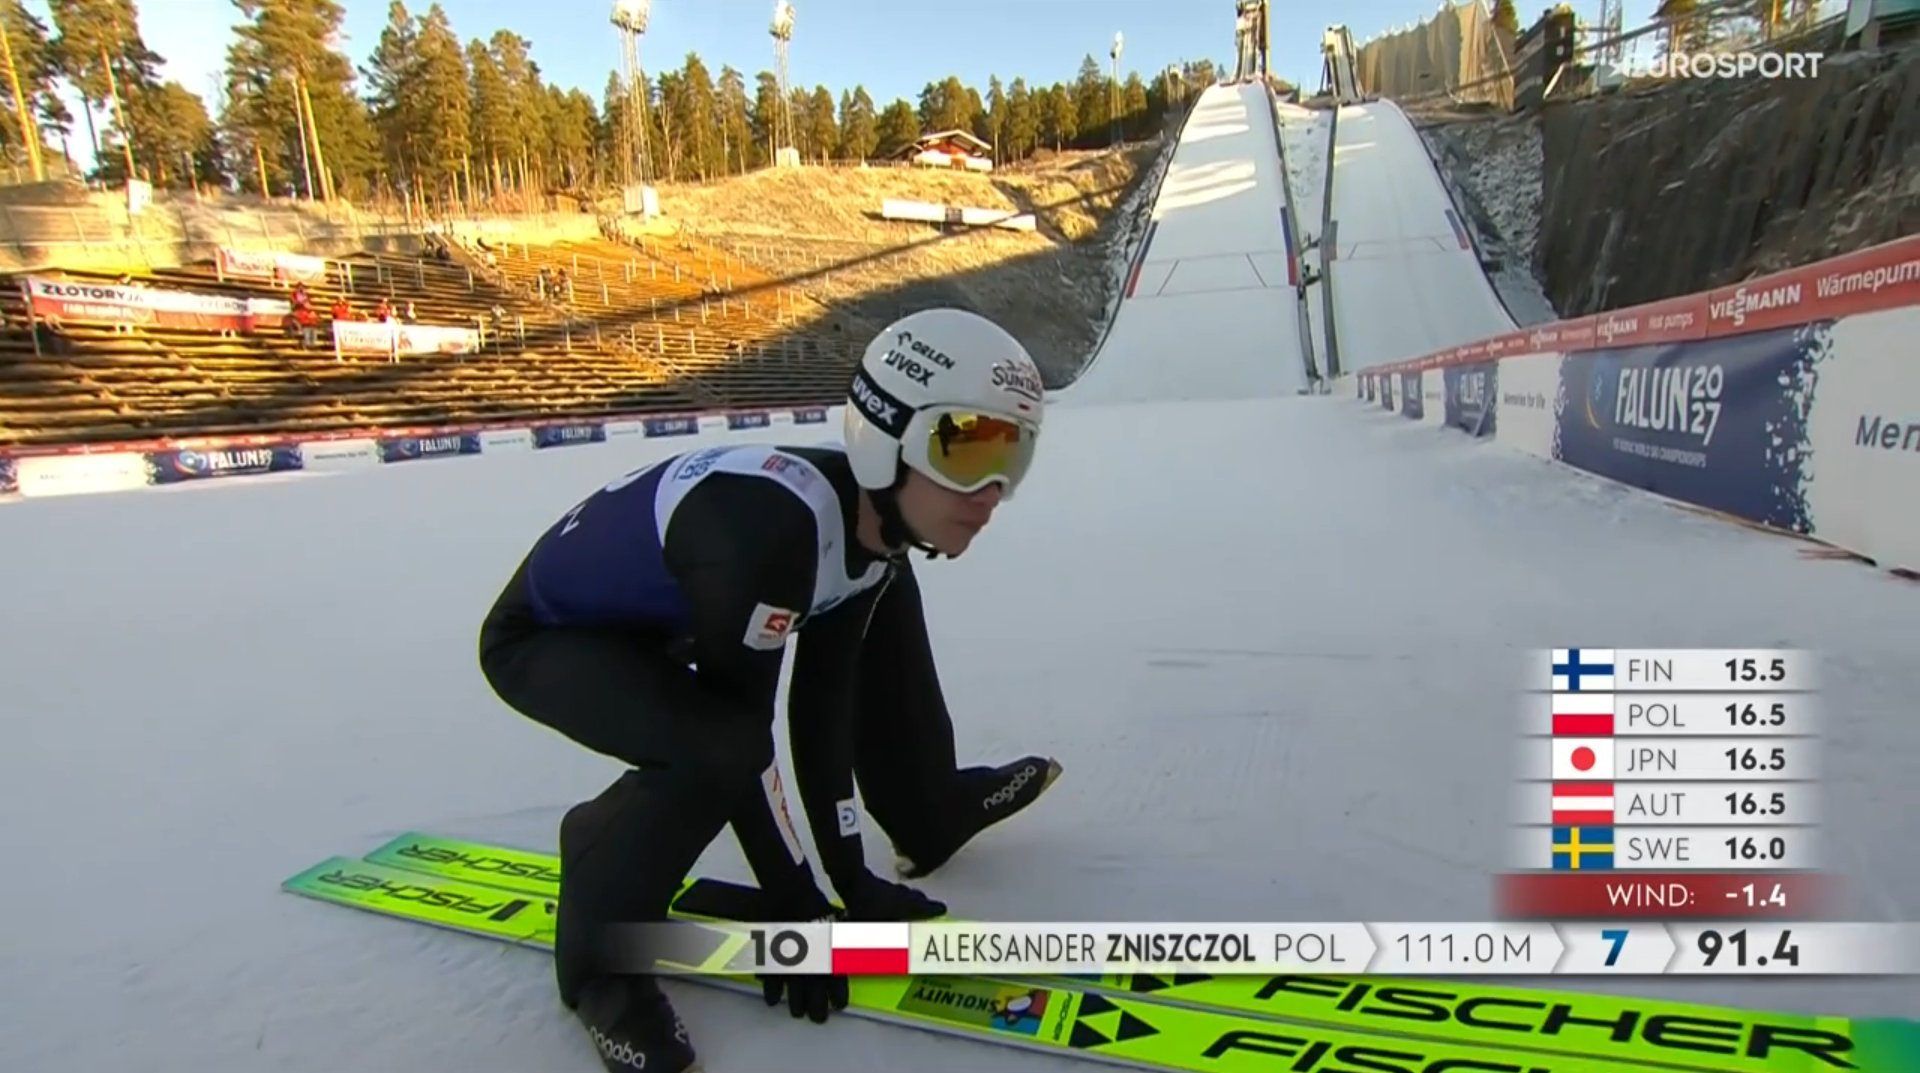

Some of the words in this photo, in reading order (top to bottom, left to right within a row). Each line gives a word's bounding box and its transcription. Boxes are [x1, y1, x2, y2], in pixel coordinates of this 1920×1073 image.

[1710, 284, 1802, 327] VIESSMANN
[884, 349, 935, 388] uvex
[911, 340, 956, 370] ORLEN
[852, 373, 899, 426] uvex
[1615, 364, 1692, 434] FALUN
[208, 449, 258, 470] FALUN
[912, 985, 998, 1013] SKOLNITY
[1252, 974, 1862, 1070] FISCHER
